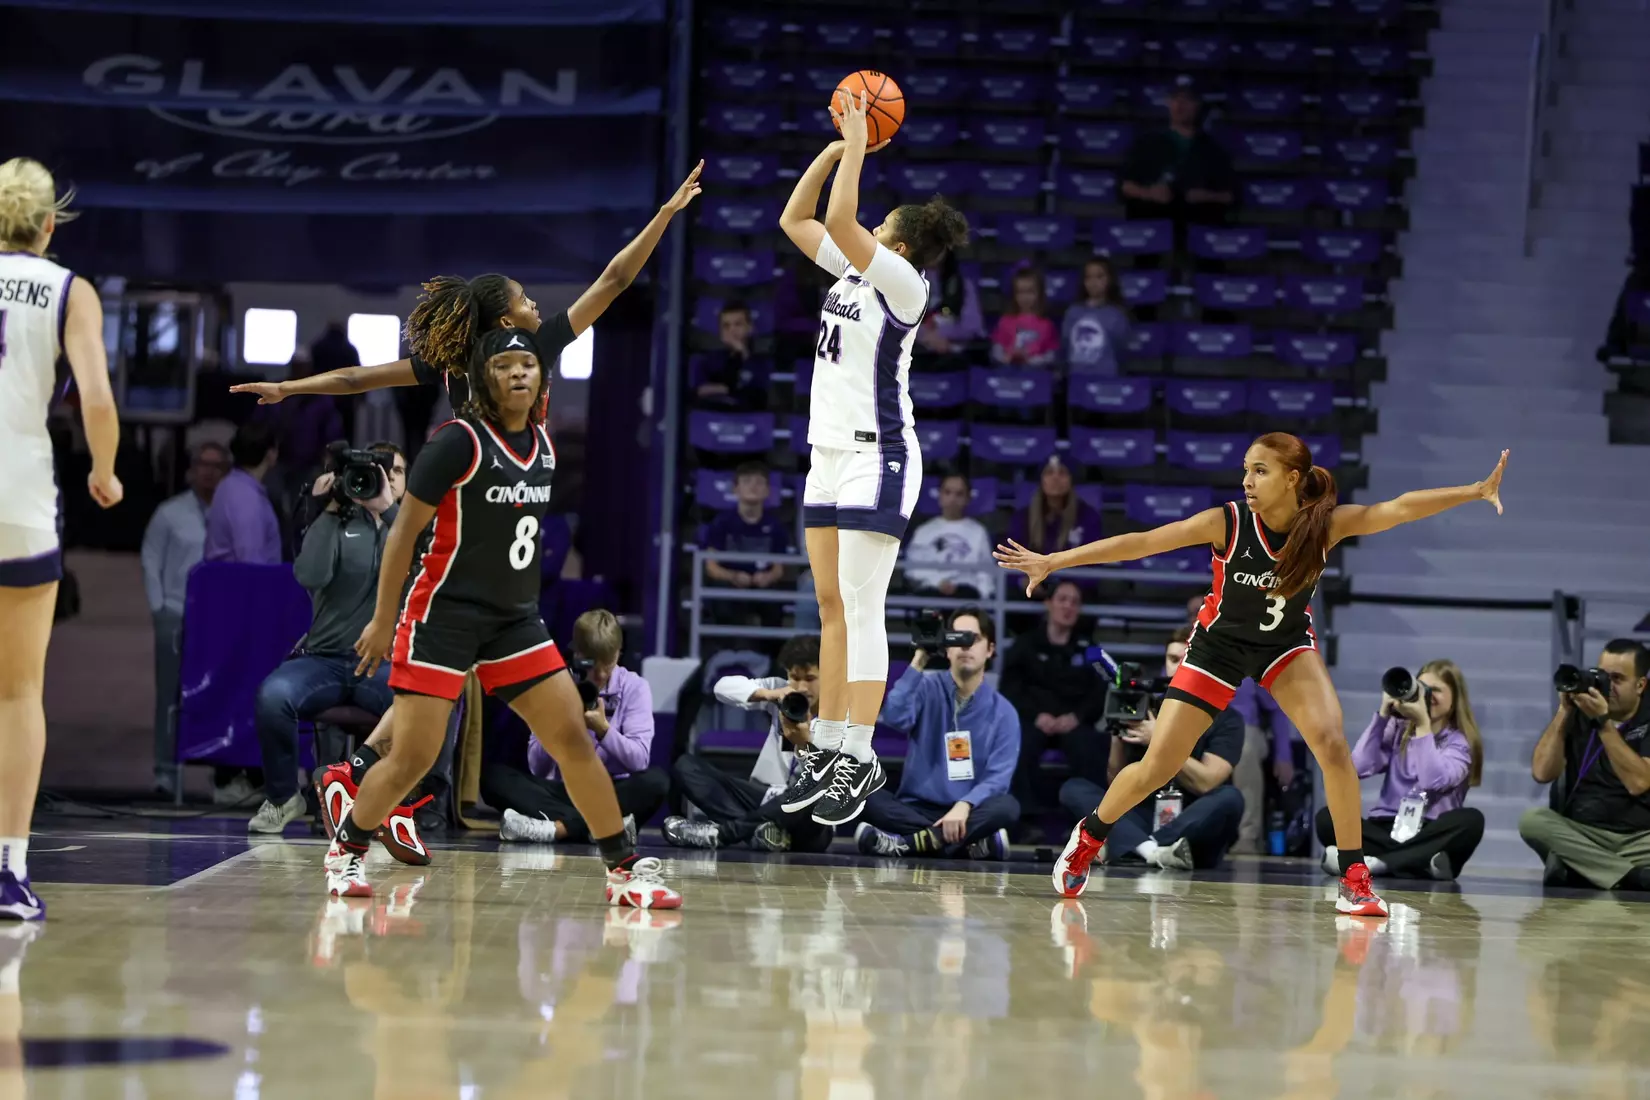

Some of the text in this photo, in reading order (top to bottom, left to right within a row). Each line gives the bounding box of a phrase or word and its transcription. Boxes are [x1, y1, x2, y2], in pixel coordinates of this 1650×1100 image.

[82, 54, 578, 106] GLAVAN
[212, 149, 327, 186] Clay
[340, 152, 496, 181] Center
[818, 320, 842, 364] 24
[509, 515, 539, 570] 8
[1259, 593, 1286, 632] 3
[1404, 806, 1415, 817] M
